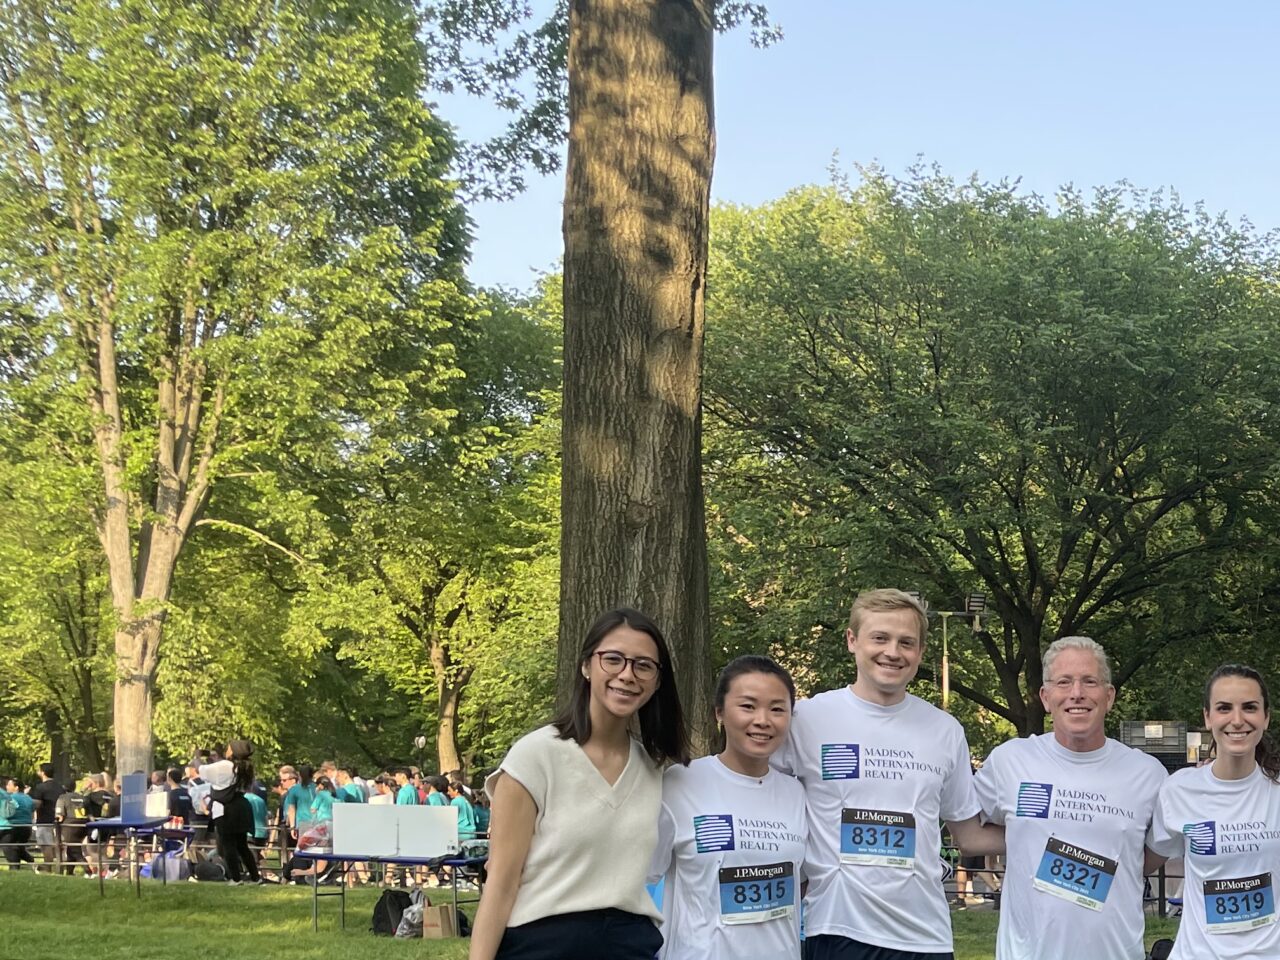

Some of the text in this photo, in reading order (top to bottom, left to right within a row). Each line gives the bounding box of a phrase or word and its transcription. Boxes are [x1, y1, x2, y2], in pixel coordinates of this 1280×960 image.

[865, 747, 914, 759] MADISON
[865, 759, 941, 775] INTERNATIONAL
[865, 770, 904, 780] REALTY
[1056, 789, 1107, 802] MADISON
[1053, 810, 1095, 822] REALTY
[1055, 800, 1135, 820] INTERNATIONAL
[739, 819, 787, 829] MADISON
[854, 811, 904, 824] J.P.Morgan
[1220, 821, 1267, 831] MADISON
[740, 829, 803, 843] INTERNATIO
[852, 826, 905, 848] 8312
[740, 841, 780, 851] REALTY
[1221, 844, 1261, 854] REALTY
[1059, 844, 1105, 867] J.P.Morgan
[734, 866, 783, 878] J.P.Morgan
[1050, 858, 1100, 890] 8321
[1215, 879, 1260, 890] J.P.Morgan
[733, 881, 785, 904] 8315
[1216, 892, 1264, 914] 8319
